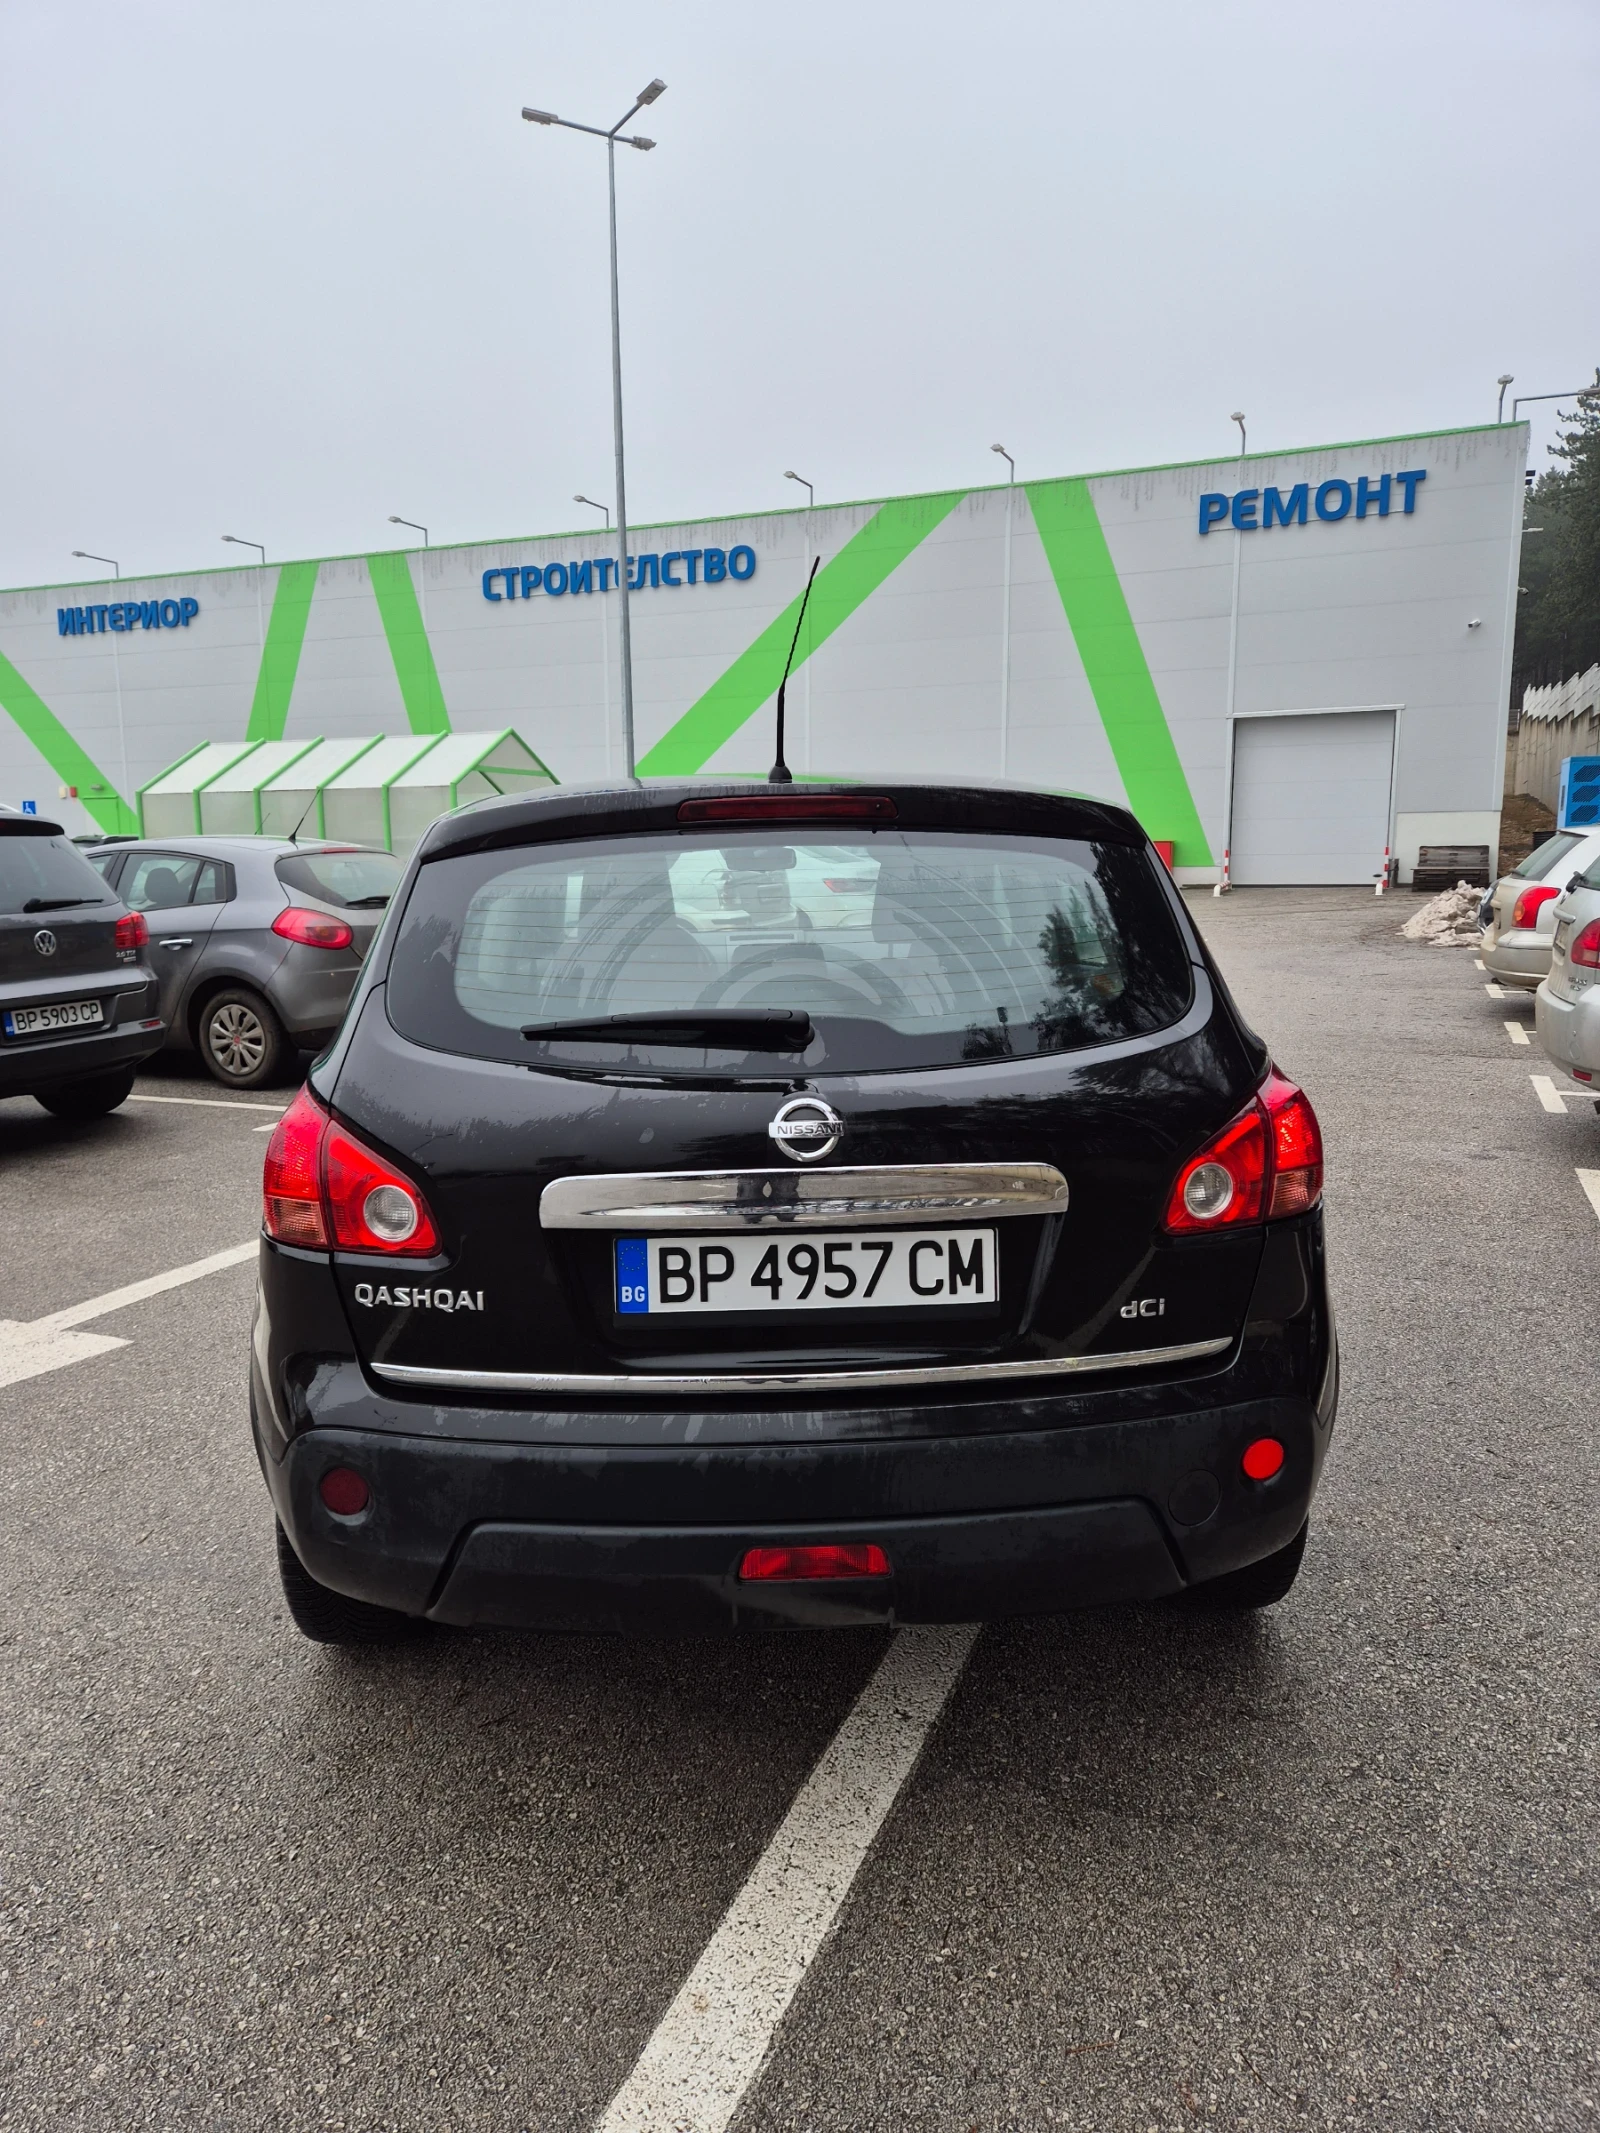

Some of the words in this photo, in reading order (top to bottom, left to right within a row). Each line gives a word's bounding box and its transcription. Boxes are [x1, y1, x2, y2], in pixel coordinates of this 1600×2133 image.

[1199, 469, 1427, 534] РЕМОНТ
[57, 597, 199, 636] ИНТЕРИОР
[40, 1005, 79, 1027] 5903
[777, 1124, 838, 1135] NISSAN
[658, 1245, 735, 1303] BP
[750, 1241, 893, 1300] 4957
[908, 1238, 984, 1296] CM
[354, 1283, 485, 1313] QASHQAI
[621, 1285, 646, 1303] BG
[1120, 1298, 1166, 1319] dCi
